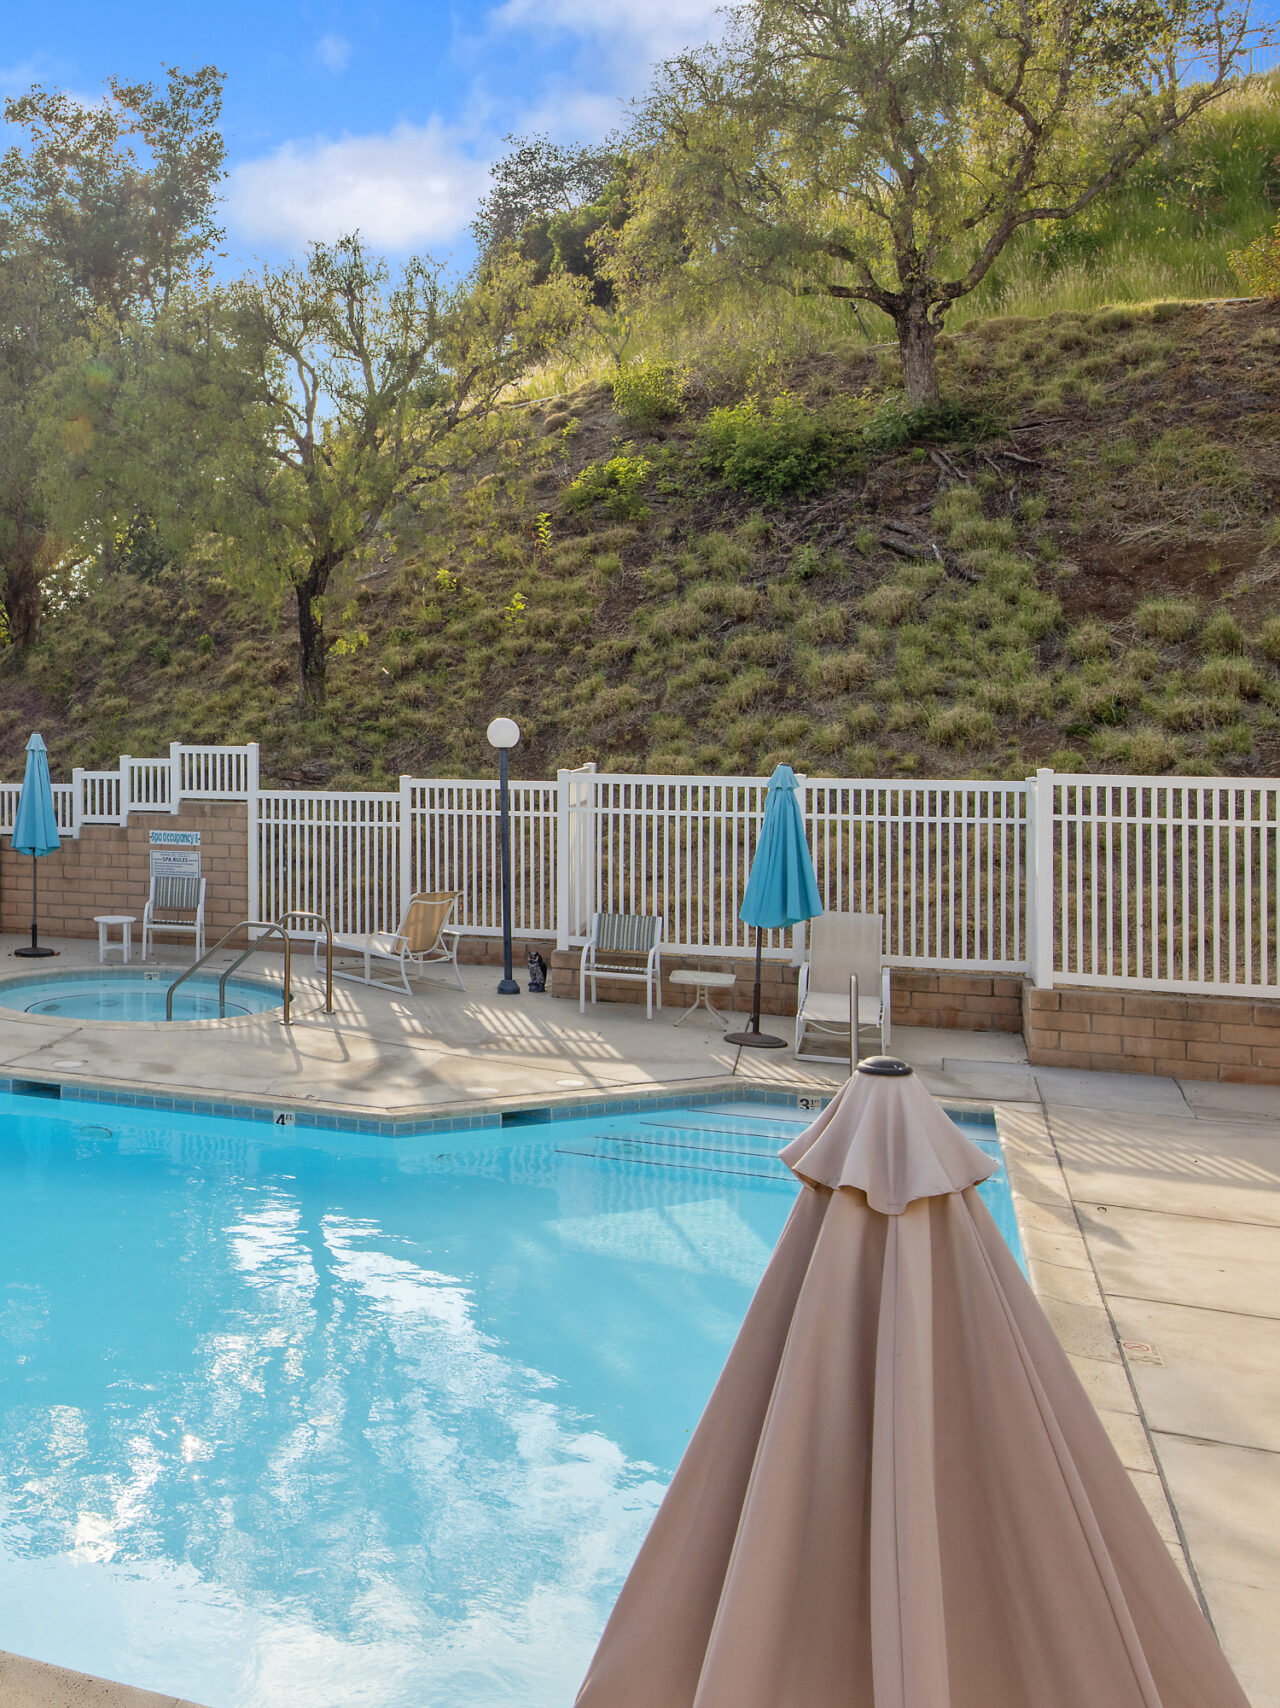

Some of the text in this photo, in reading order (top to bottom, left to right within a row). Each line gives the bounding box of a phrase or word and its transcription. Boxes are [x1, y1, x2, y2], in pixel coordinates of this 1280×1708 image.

[151, 832, 162, 843] Spa
[800, 1099, 809, 1109] 3
[276, 1113, 287, 1125] 4
